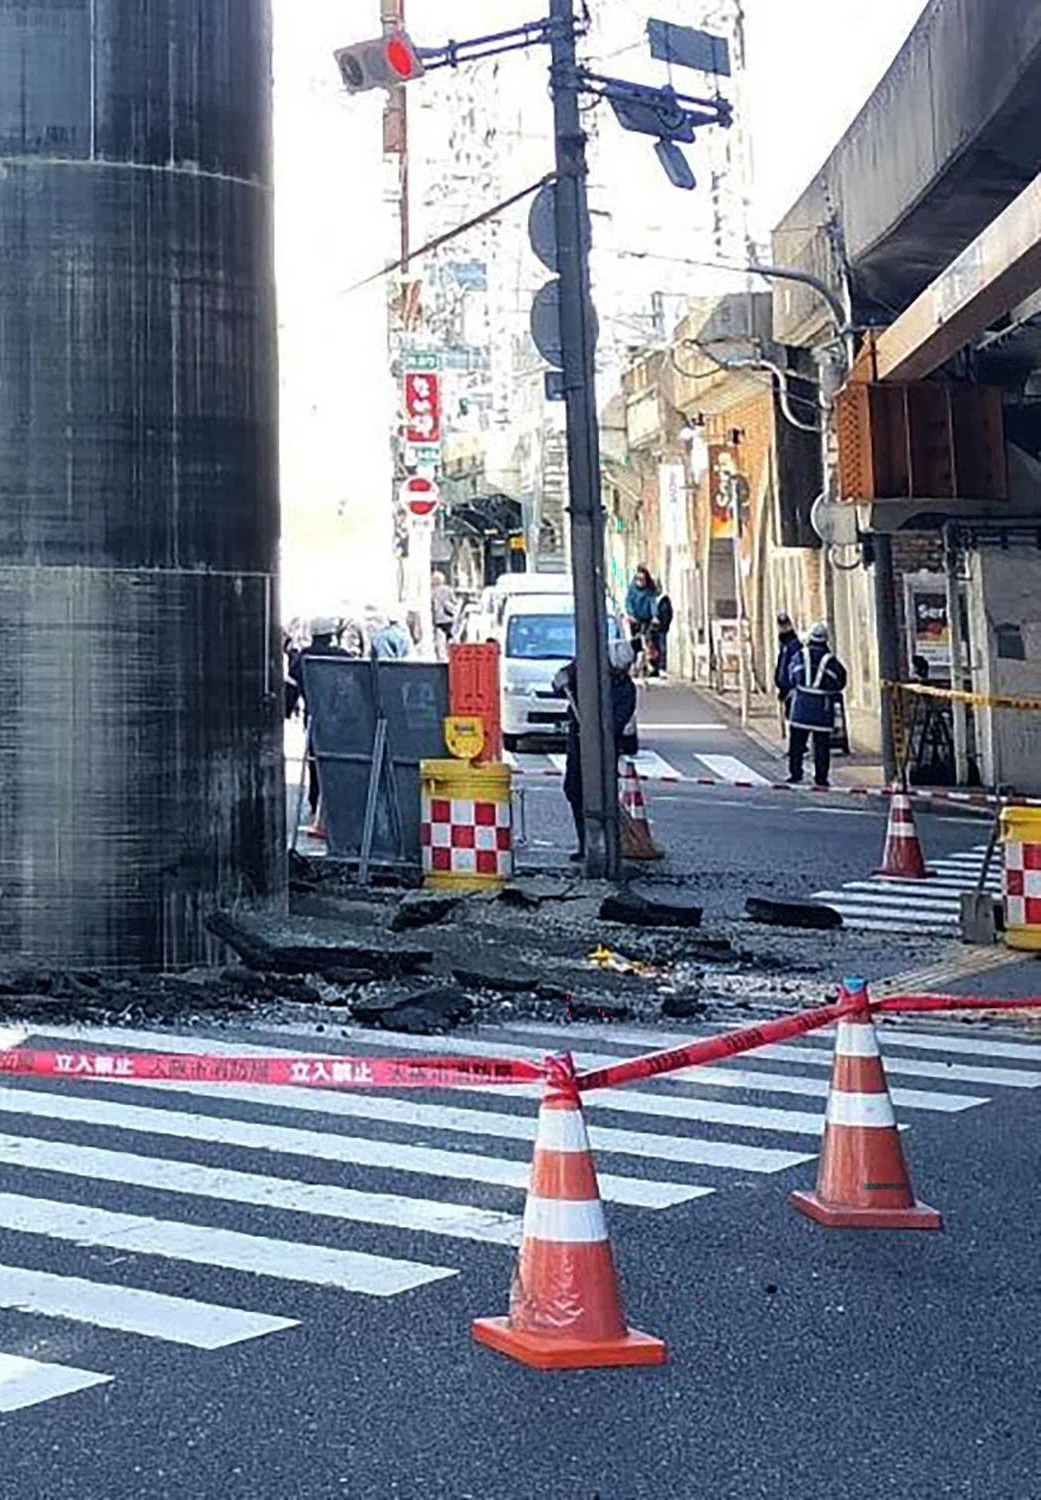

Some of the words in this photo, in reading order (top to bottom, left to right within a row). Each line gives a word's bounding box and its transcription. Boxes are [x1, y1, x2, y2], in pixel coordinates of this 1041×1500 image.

[54, 1052, 134, 1075] 立入禁止
[289, 1061, 373, 1083] 立入禁止
